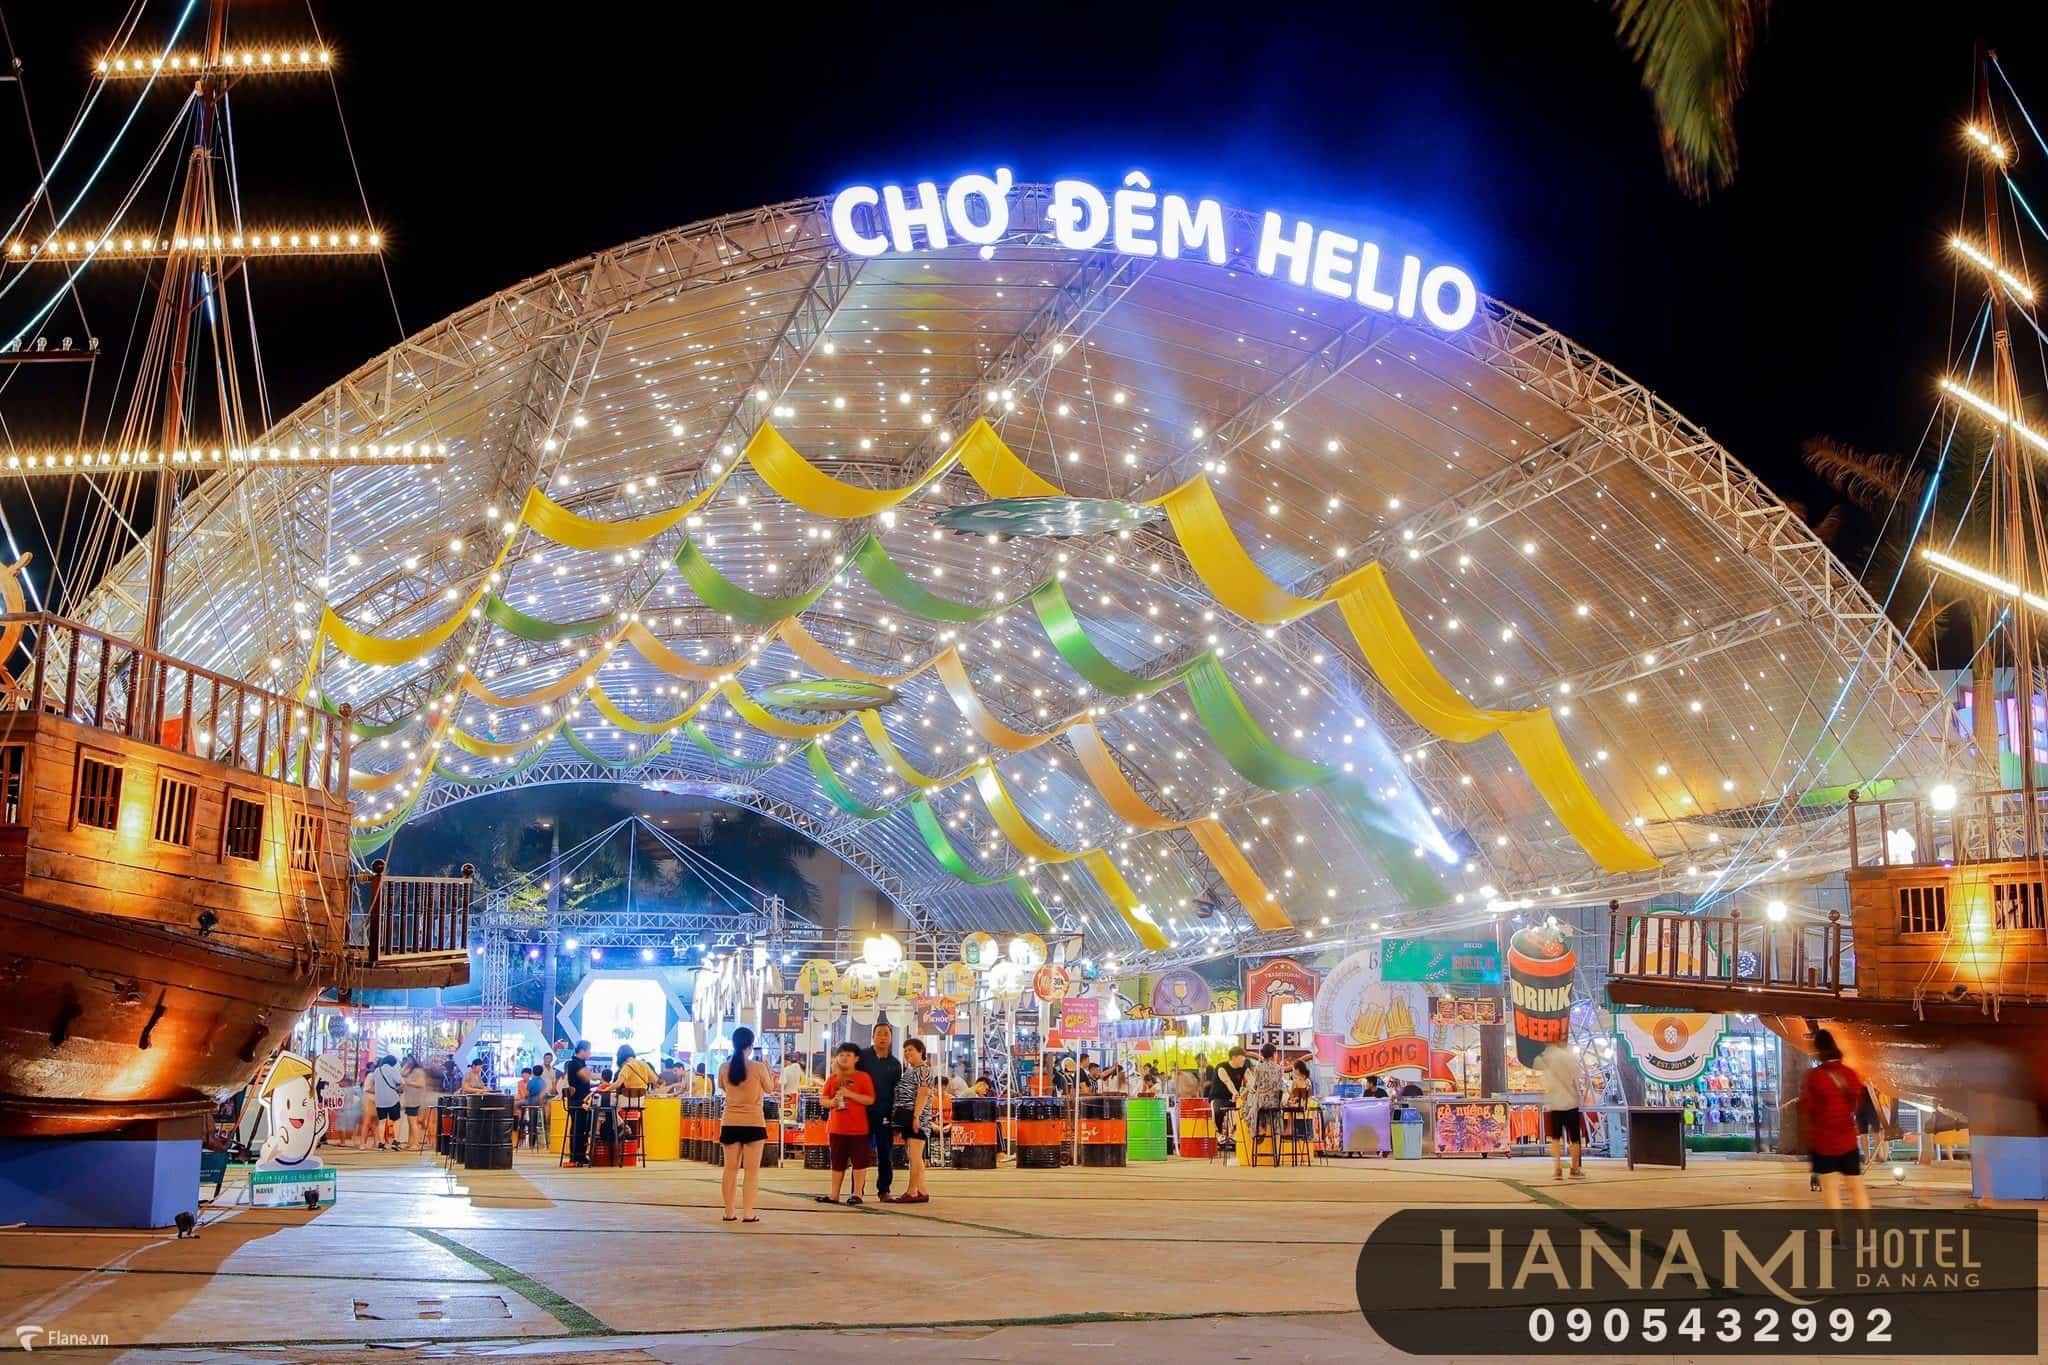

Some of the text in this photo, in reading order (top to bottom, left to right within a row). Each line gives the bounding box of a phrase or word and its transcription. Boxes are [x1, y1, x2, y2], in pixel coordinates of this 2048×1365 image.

[831, 167, 1478, 332] CHỢ ĐÊM HELIO
[1511, 978, 1573, 1012] DRINK
[1251, 1031, 1300, 1046] BEE
[1515, 1010, 1568, 1042] BEER!
